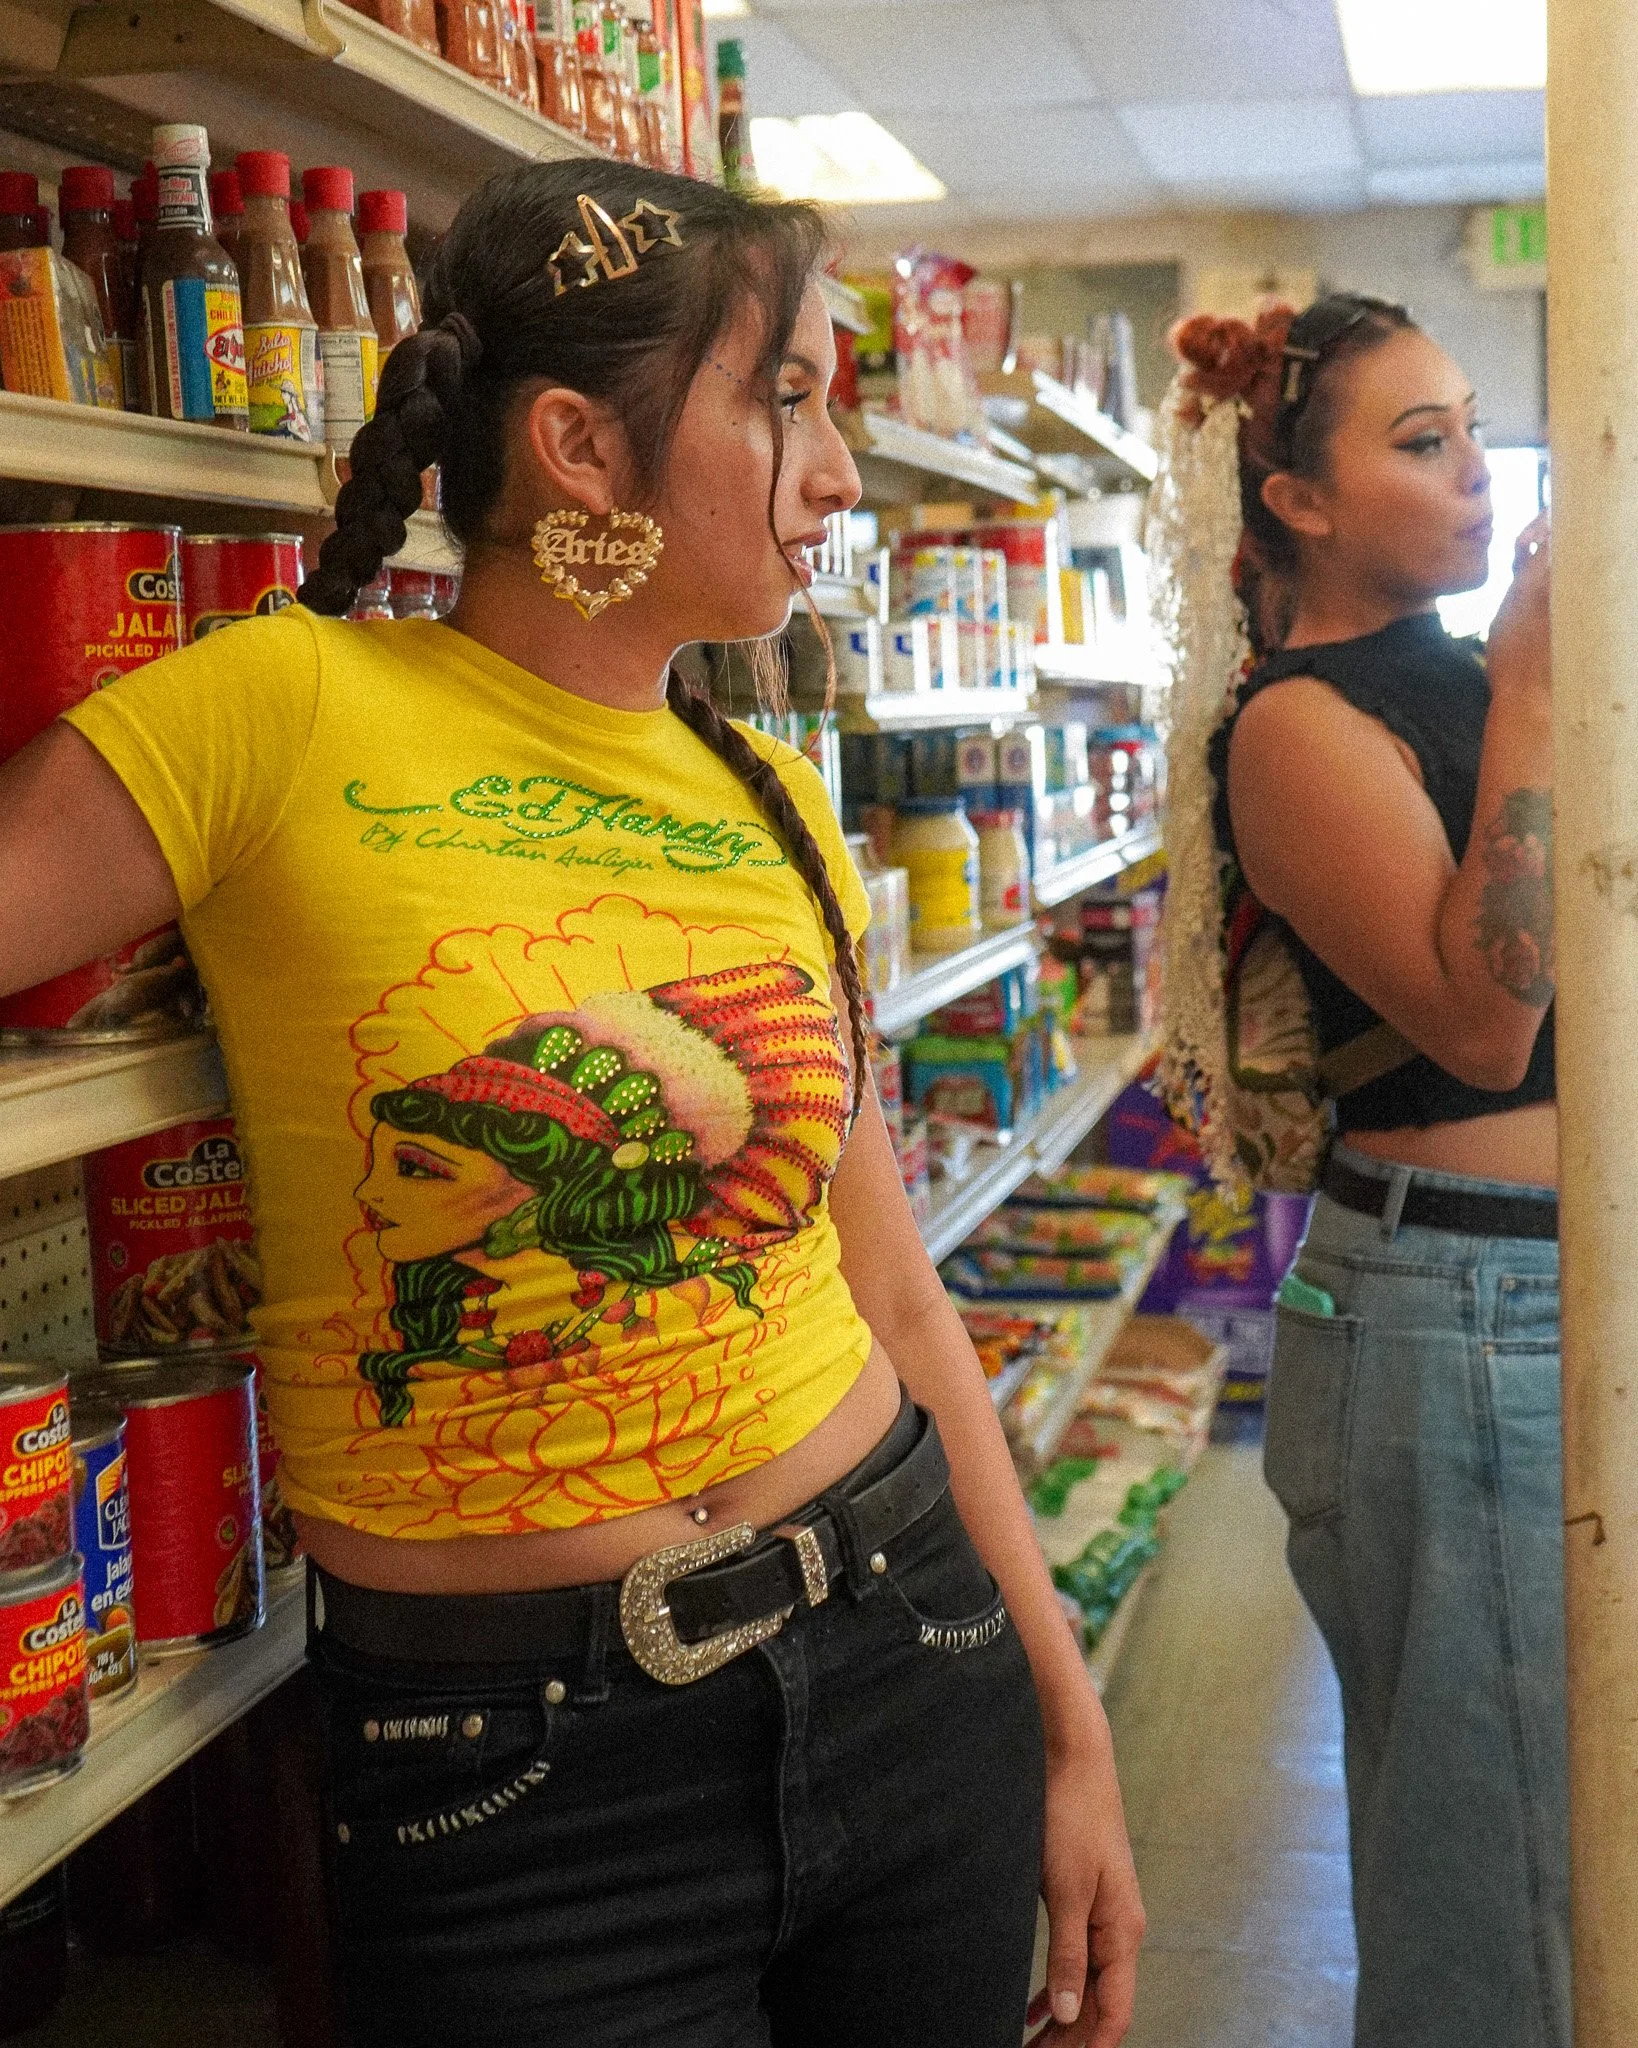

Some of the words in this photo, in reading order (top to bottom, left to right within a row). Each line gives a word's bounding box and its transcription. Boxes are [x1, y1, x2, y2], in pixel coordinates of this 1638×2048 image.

[541, 528, 648, 566] Aries
[84, 644, 155, 658] PICKLED
[449, 775, 566, 824] Ed
[203, 1142, 230, 1160] La
[111, 1196, 187, 1216] SLICED
[129, 1218, 181, 1230] PICKLED
[91, 1590, 114, 1612] en
